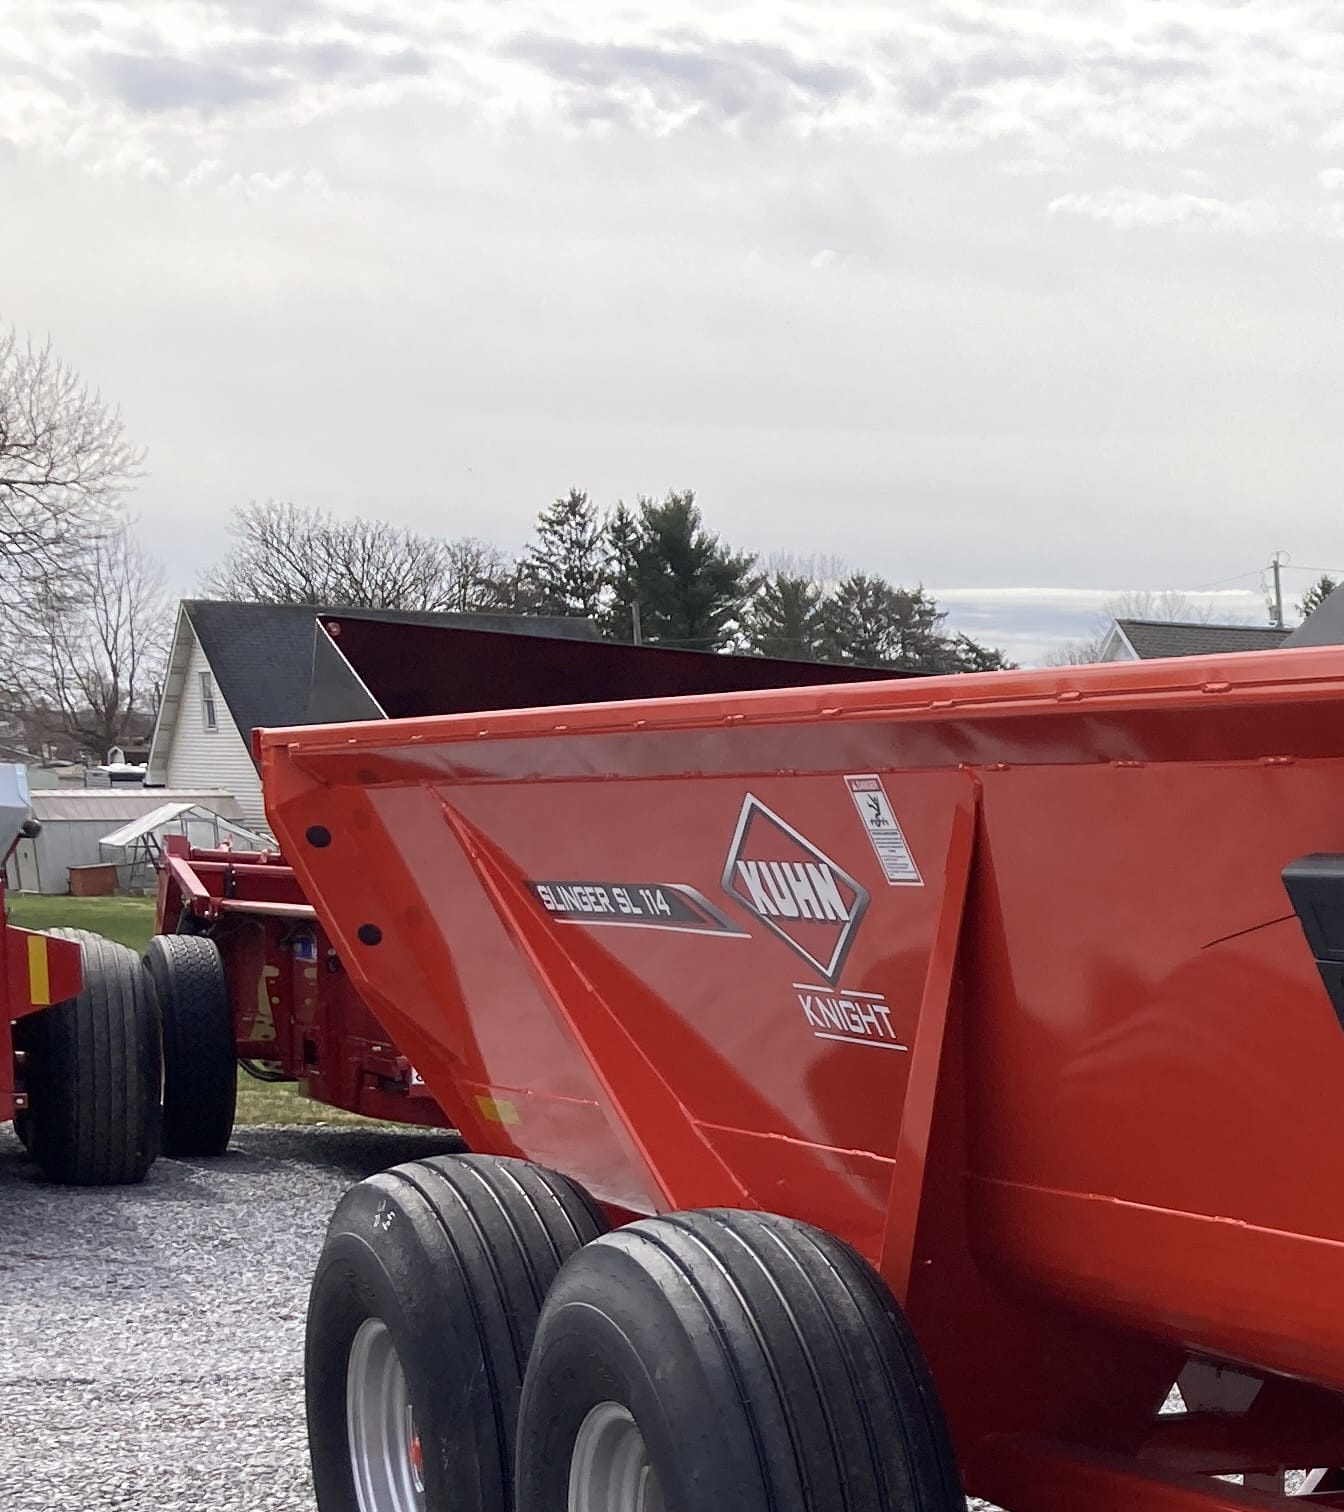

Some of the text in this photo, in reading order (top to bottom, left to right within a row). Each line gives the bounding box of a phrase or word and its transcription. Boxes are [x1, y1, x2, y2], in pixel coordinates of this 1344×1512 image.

[536, 885, 672, 916] SLINGER SL 114
[735, 860, 851, 922] KUHN
[798, 993, 897, 1039] KNIGHT
